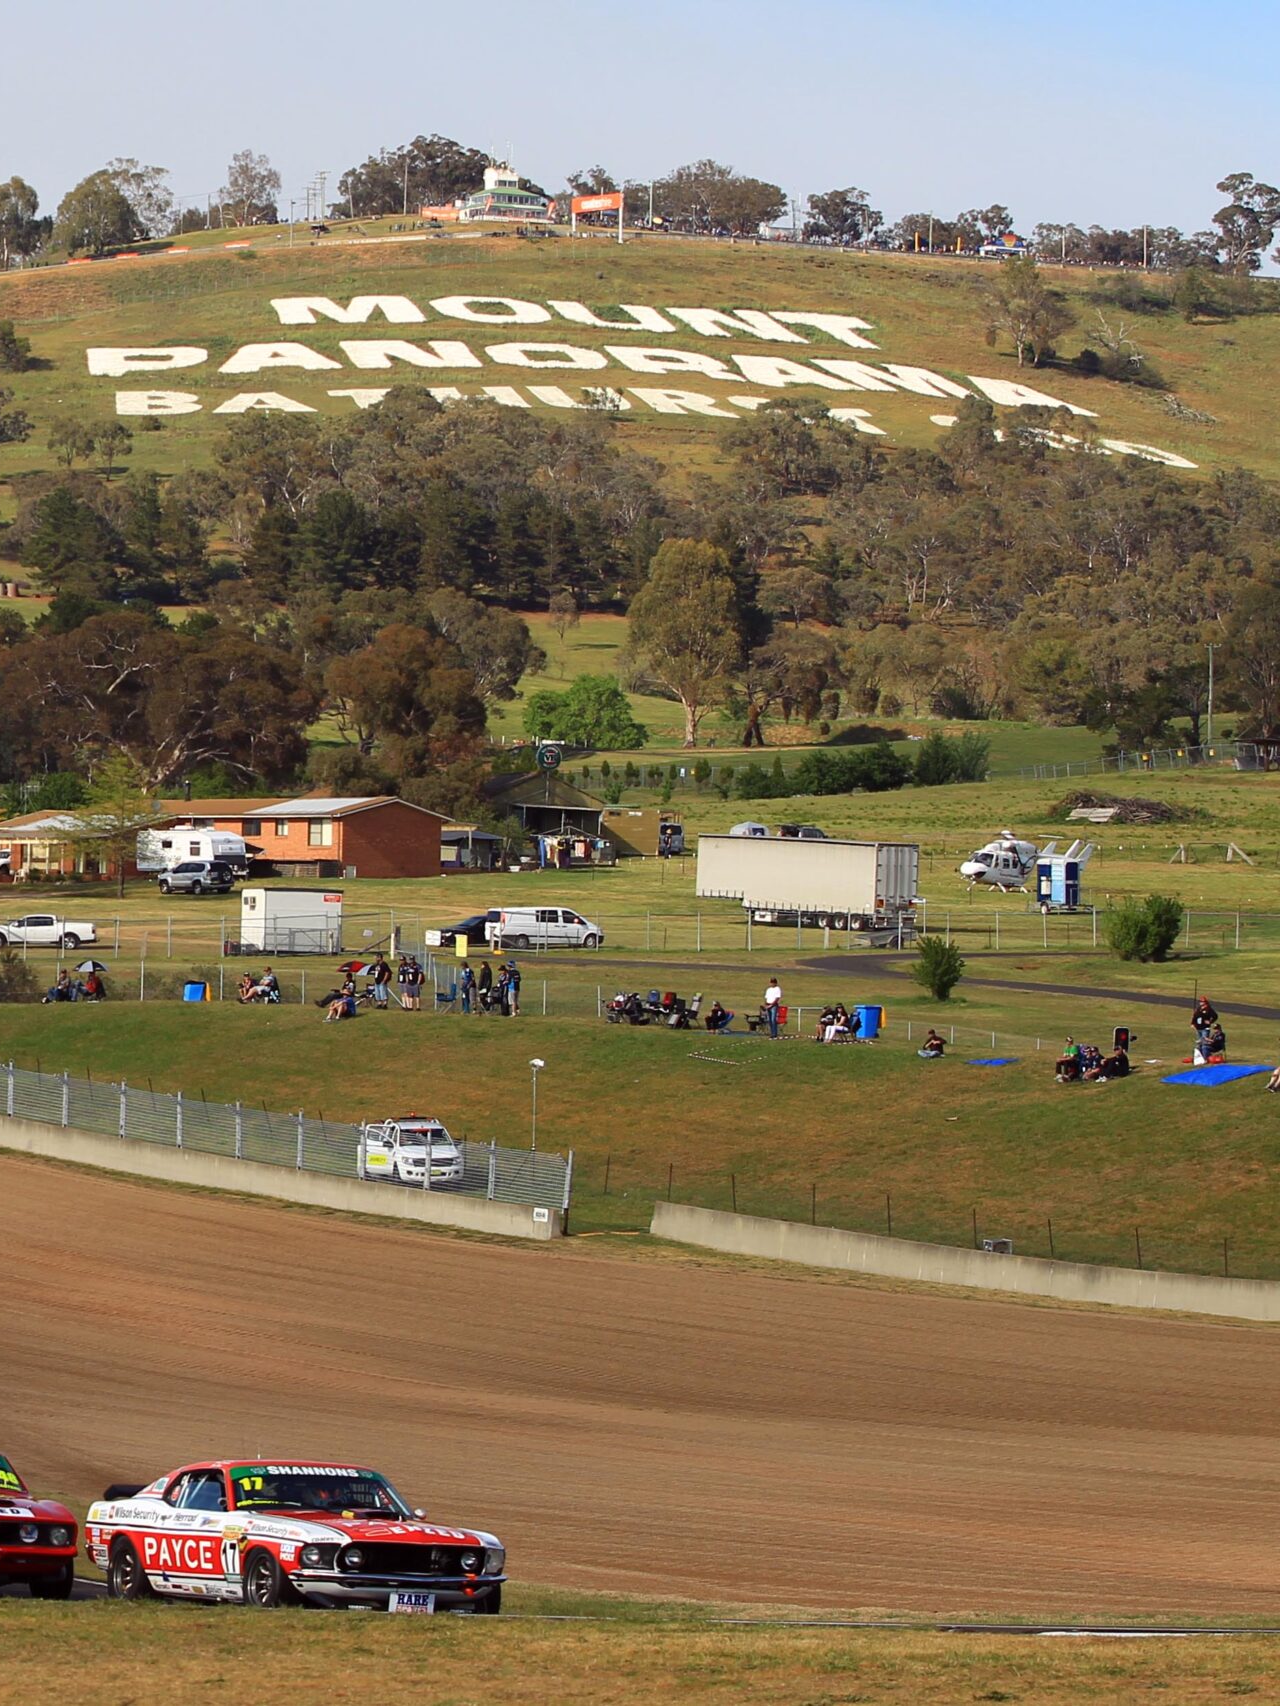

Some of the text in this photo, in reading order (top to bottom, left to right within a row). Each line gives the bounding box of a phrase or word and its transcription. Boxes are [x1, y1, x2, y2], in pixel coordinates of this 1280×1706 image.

[271, 295, 881, 350] MOUNT
[86, 340, 1100, 417] PANORAMA
[266, 1465, 359, 1478] SHANNONS
[238, 1476, 264, 1491] 17
[115, 1507, 160, 1523] Wilson Security
[389, 1524, 466, 1539] ENZED
[144, 1536, 213, 1569] PAYCE
[222, 1541, 237, 1573] 17
[397, 1594, 429, 1605] RARE
